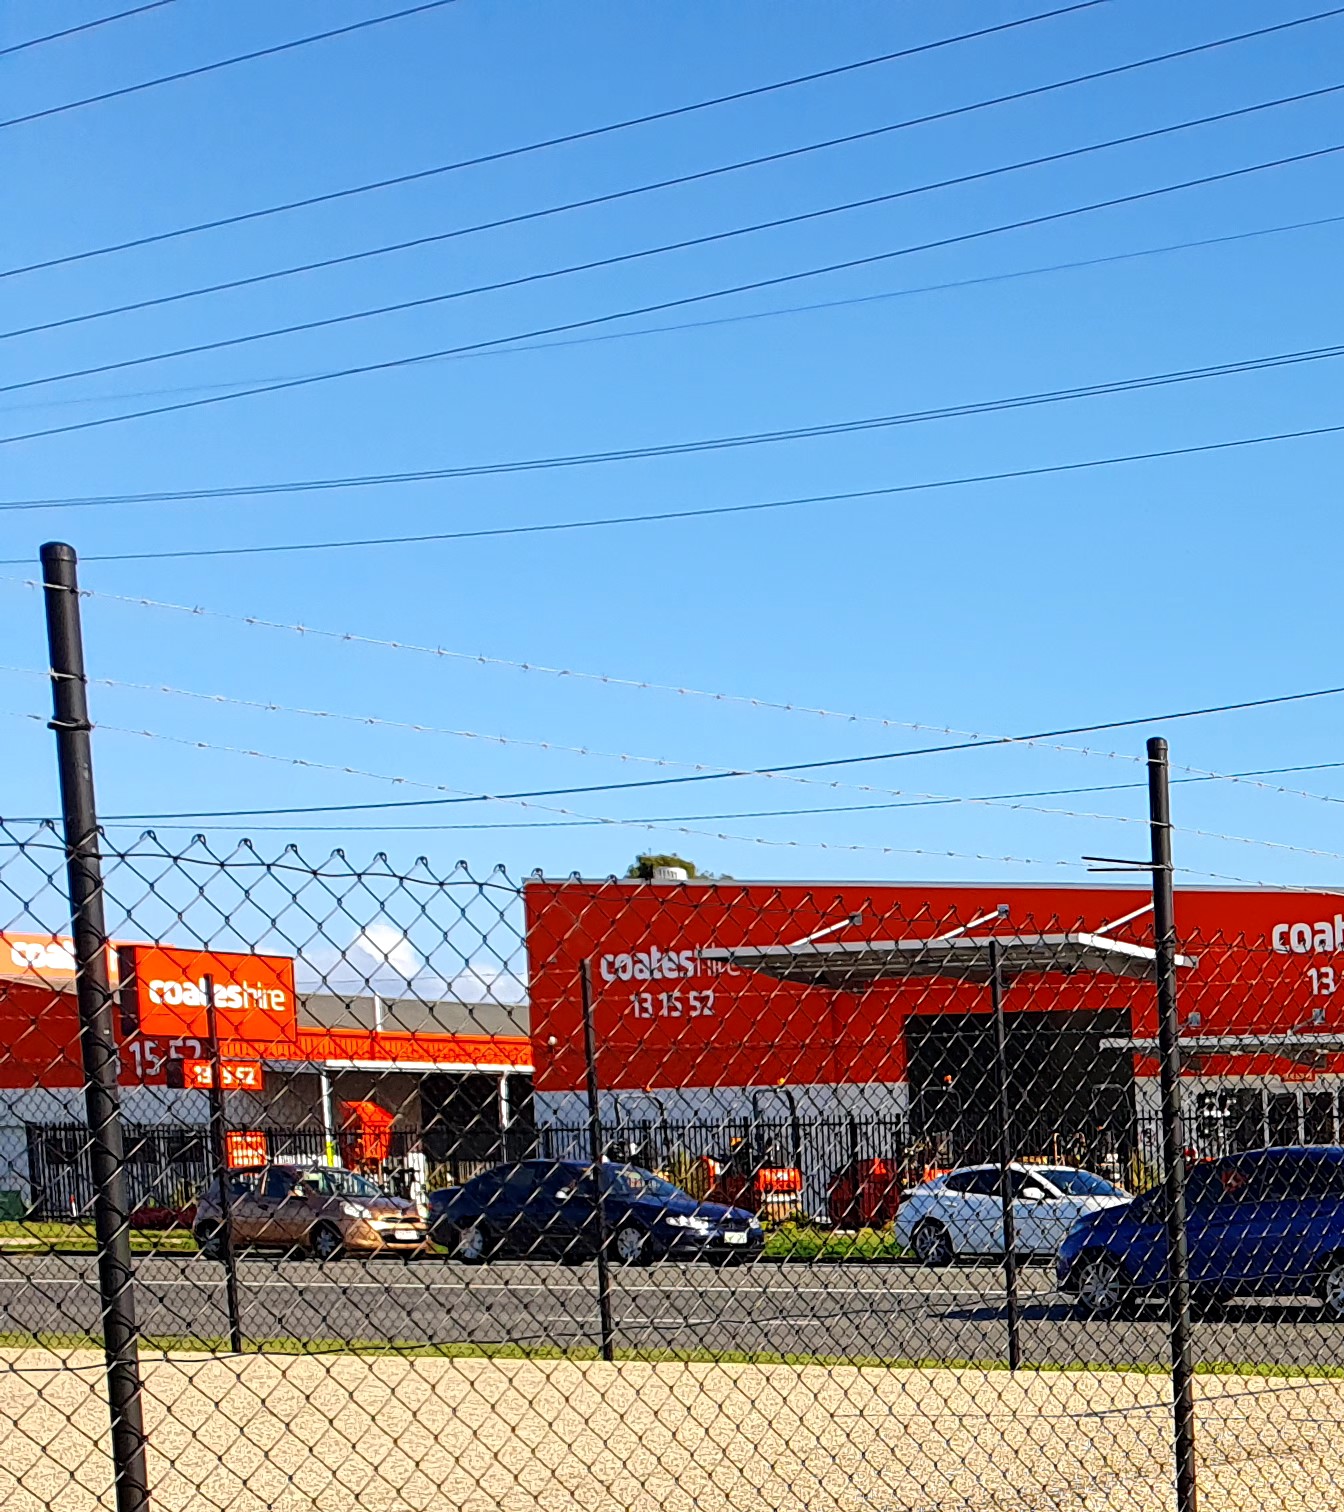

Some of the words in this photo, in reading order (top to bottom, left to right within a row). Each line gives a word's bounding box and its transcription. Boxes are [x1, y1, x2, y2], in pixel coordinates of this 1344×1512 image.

[1307, 966, 1335, 995] 13
[629, 992, 653, 1018] 13
[659, 990, 683, 1017] 15
[689, 990, 715, 1016] 52
[129, 1040, 161, 1078] 15
